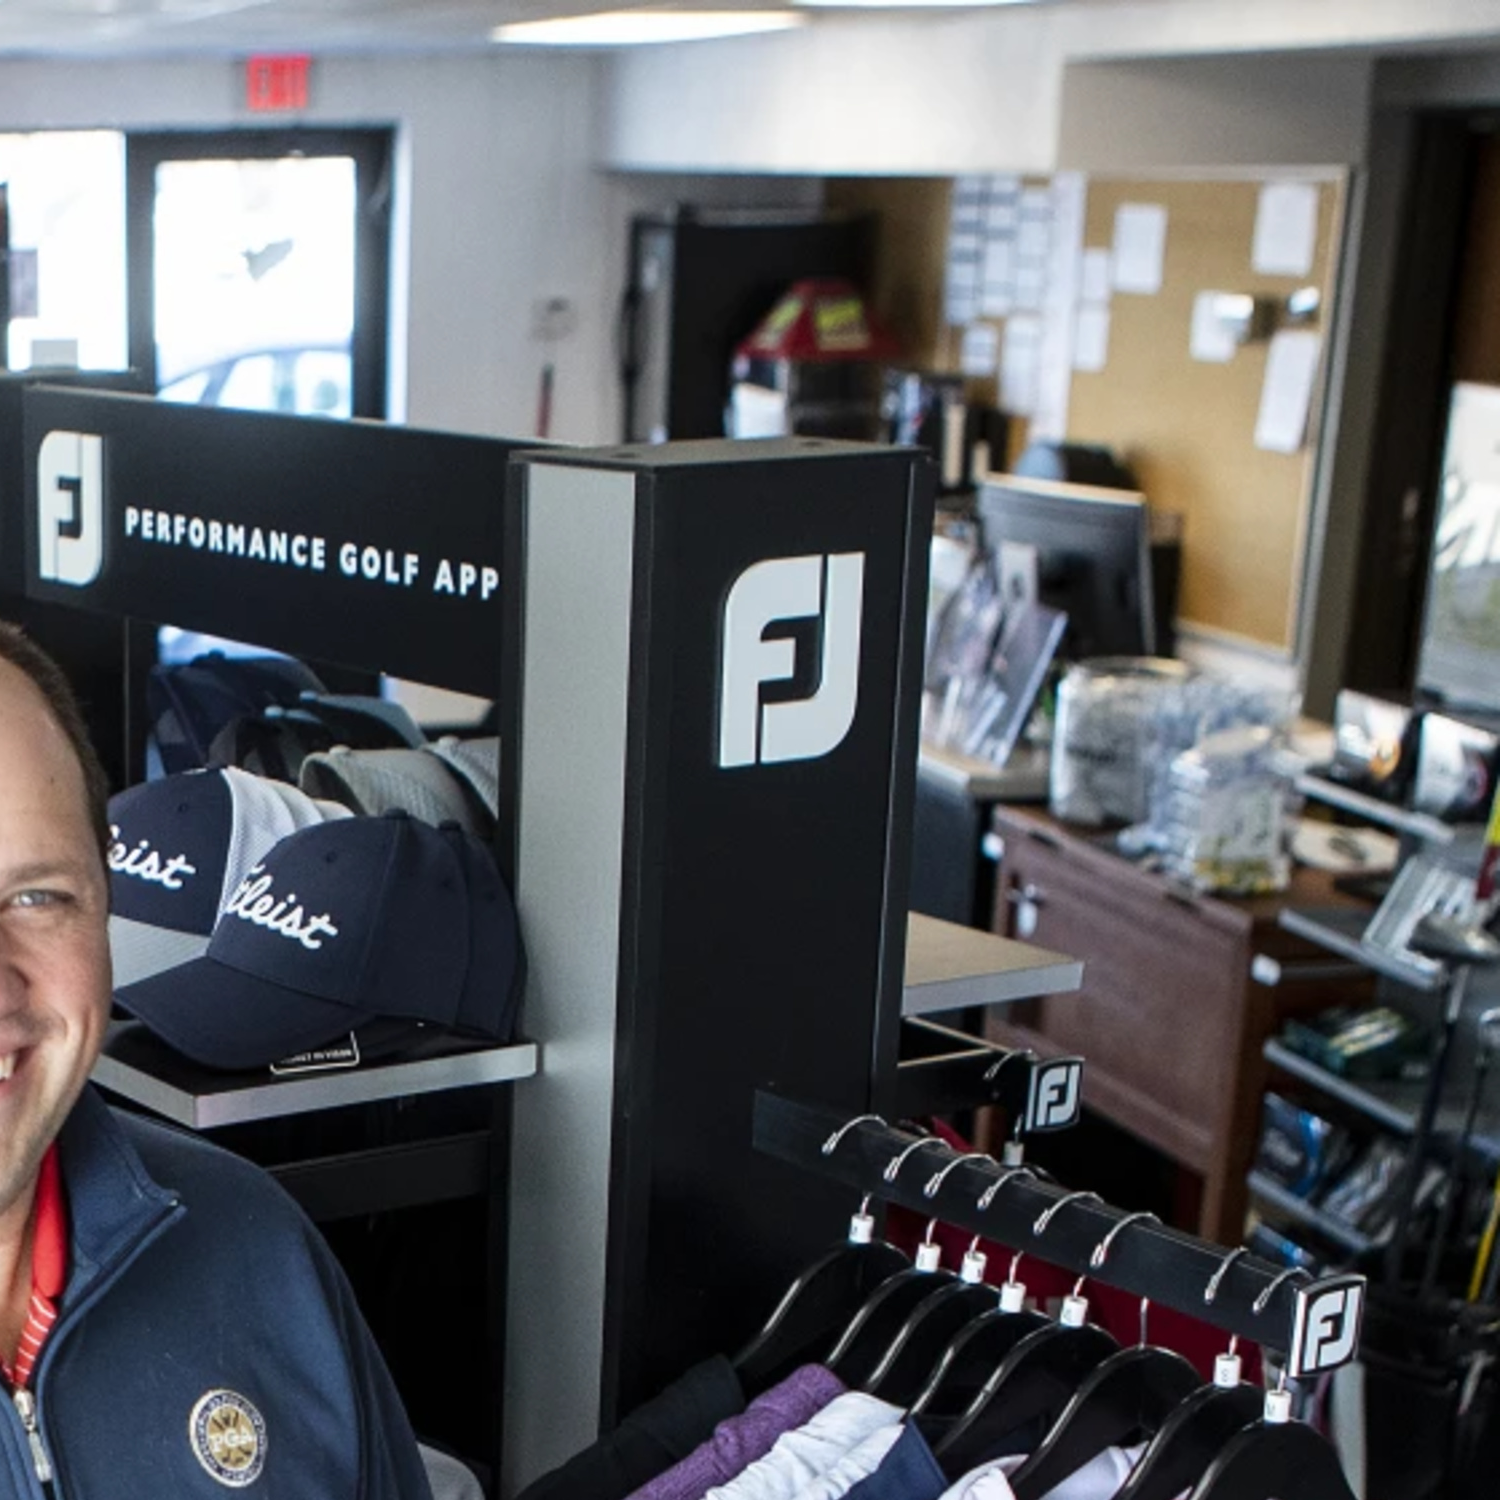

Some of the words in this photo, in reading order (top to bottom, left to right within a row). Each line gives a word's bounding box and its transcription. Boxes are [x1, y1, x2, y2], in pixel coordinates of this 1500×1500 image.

[38, 430, 102, 586] FJ
[125, 506, 326, 570] PERFORMANCE
[339, 542, 419, 585] GOLF
[433, 559, 499, 600] APP
[719, 551, 865, 768] FJ
[1036, 1065, 1080, 1126] FJ
[1303, 1285, 1361, 1371] FJ
